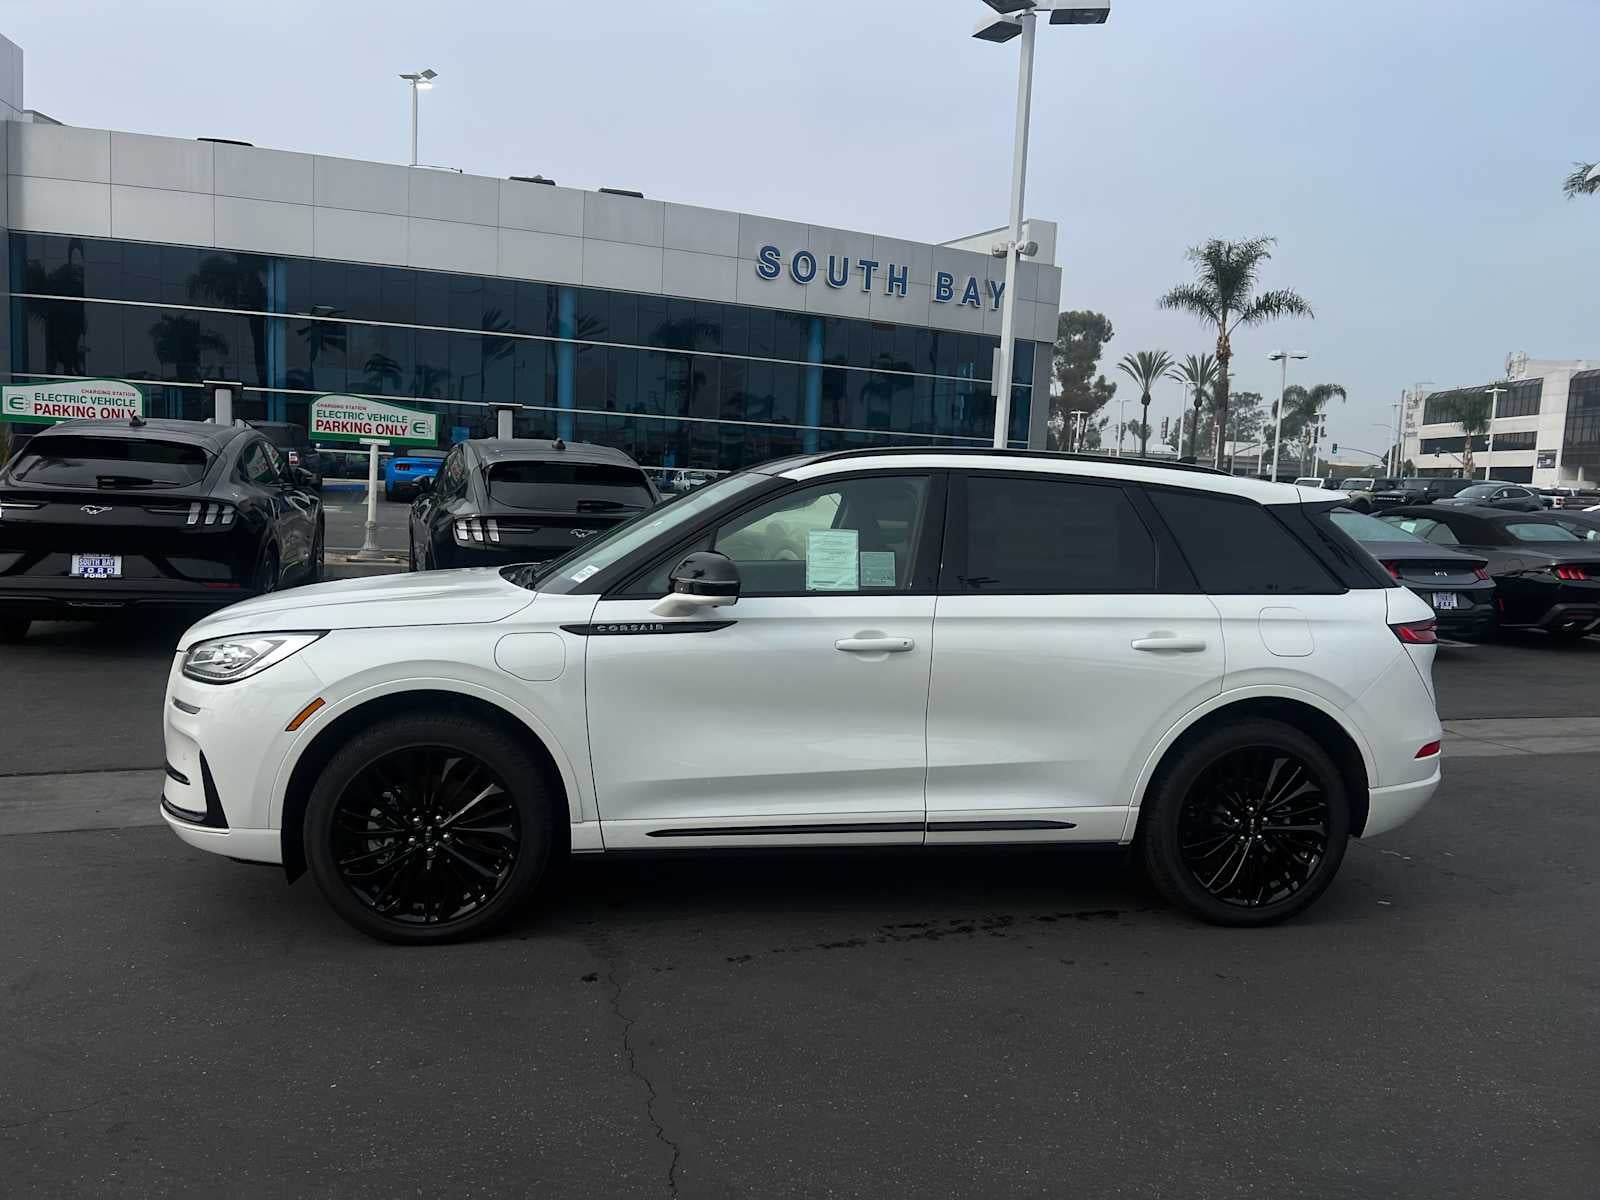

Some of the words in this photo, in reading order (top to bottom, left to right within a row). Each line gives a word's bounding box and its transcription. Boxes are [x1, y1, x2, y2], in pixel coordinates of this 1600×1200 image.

[757, 245, 908, 296] SOUTH
[934, 271, 1005, 311] BAY
[34, 392, 87, 404] ELECTRIC
[91, 395, 136, 408] VEHICLE
[34, 403, 96, 418] PARKING
[316, 409, 365, 420] ELECTRIC
[367, 413, 408, 424] VEHICLE
[316, 419, 372, 433] PARKING
[375, 423, 408, 436] ONLY
[597, 623, 664, 632] CORSAIR
